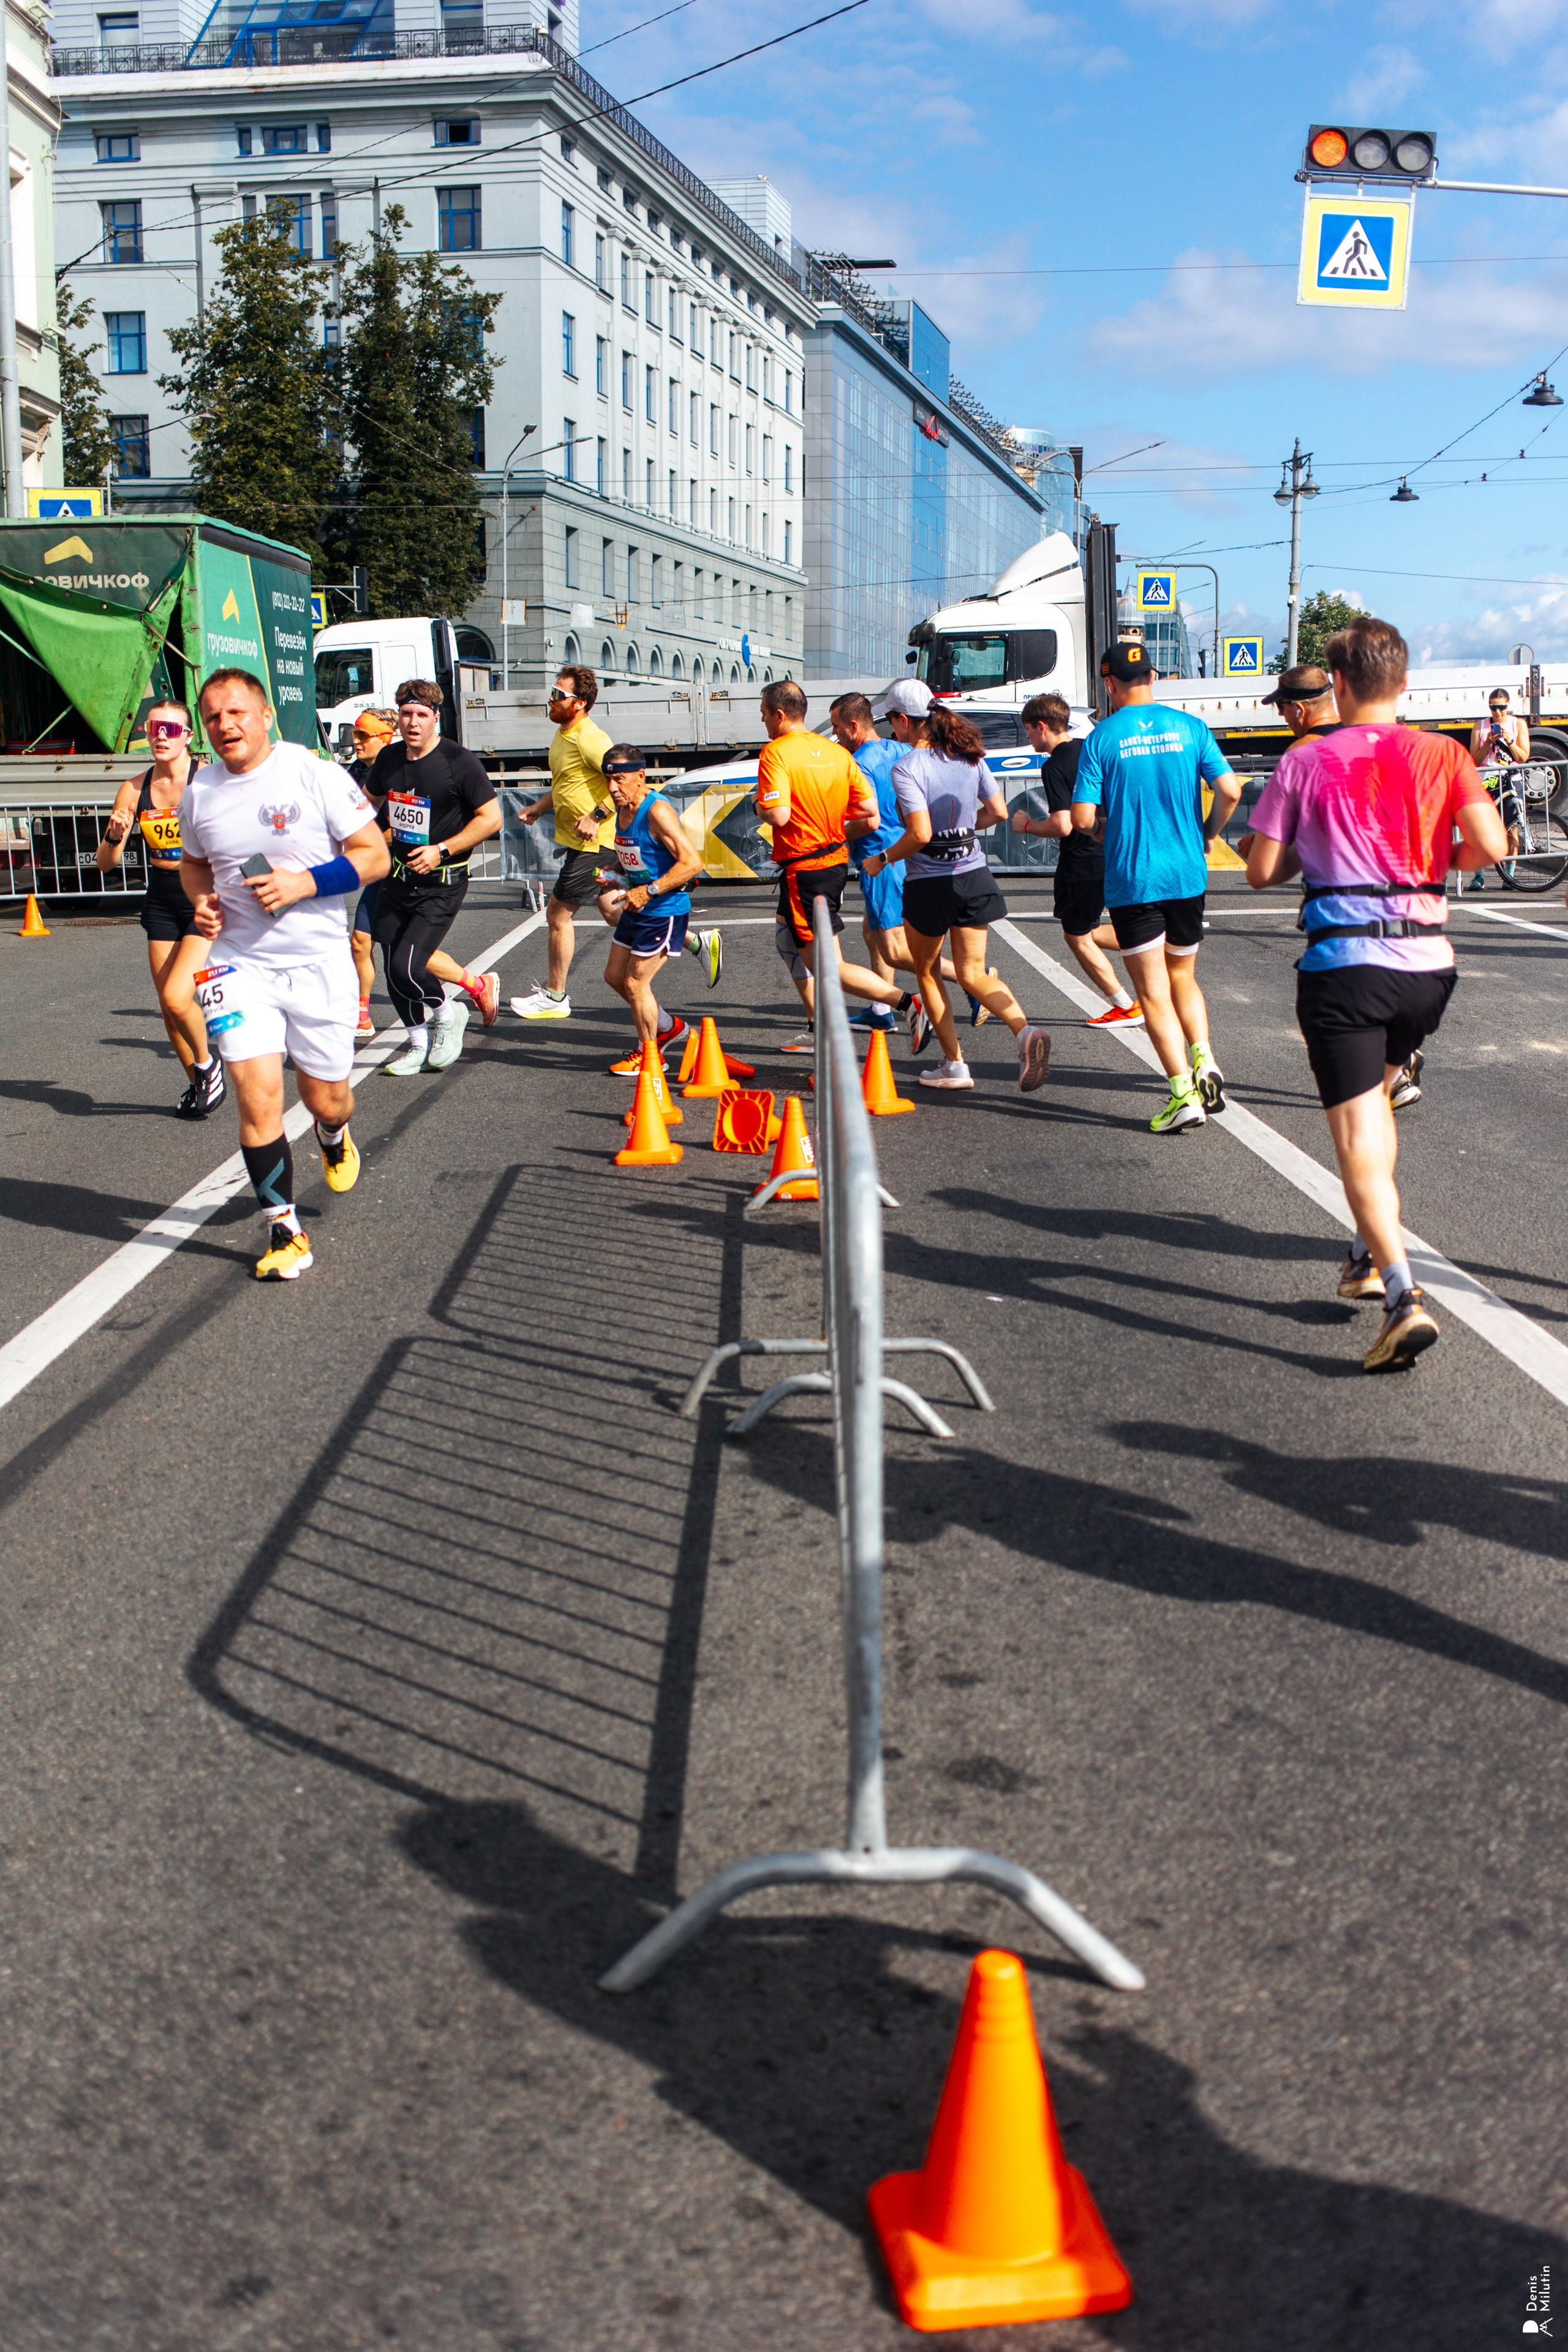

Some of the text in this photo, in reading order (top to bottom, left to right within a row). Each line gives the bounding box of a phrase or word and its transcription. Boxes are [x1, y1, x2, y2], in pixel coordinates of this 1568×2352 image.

[275, 626, 306, 653] Перевезём
[1128, 647, 1141, 663] G
[277, 656, 304, 676] на новый
[278, 686, 303, 706] уровень
[1119, 733, 1180, 748] САНКТ-ПЕТЕРБУРГ
[1120, 743, 1184, 759] БЕГОВАЯ СТОЛИЦА
[394, 806, 423, 825] 4650
[197, 983, 224, 1008] 45
